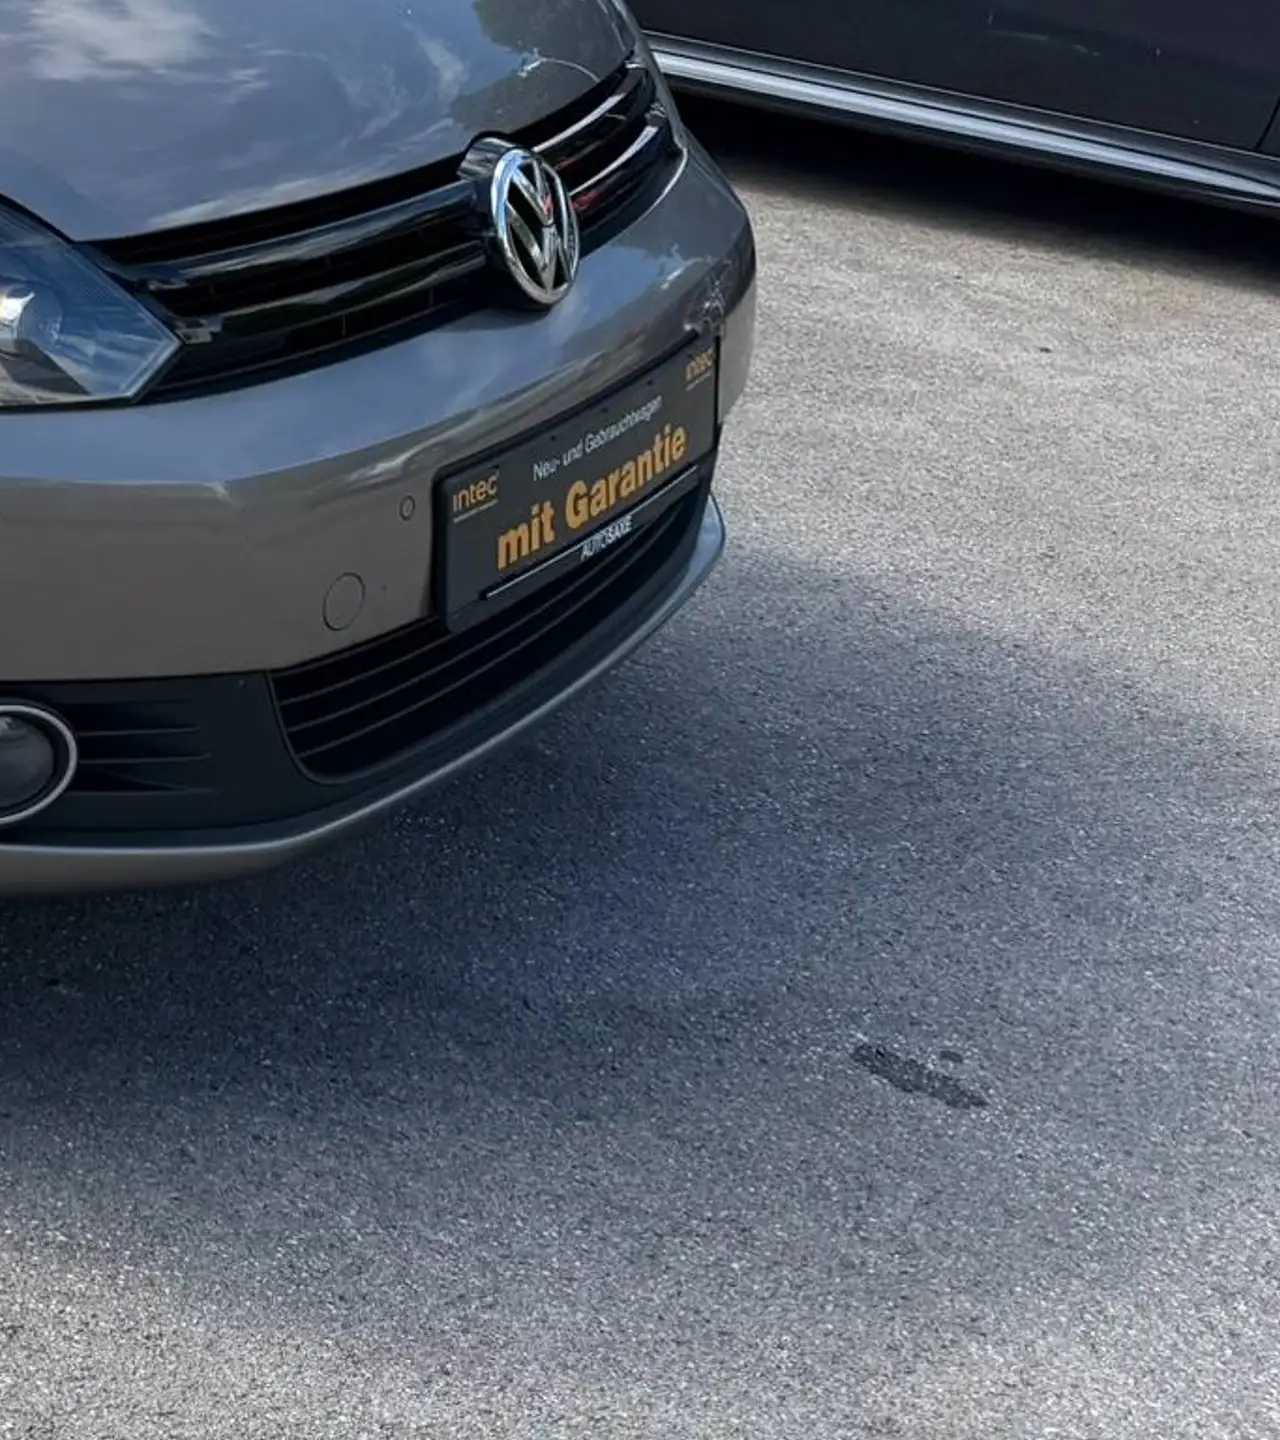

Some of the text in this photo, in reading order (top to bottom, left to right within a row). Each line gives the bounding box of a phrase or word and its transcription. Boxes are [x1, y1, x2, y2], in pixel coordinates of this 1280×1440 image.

[532, 458, 561, 482] Neu-
[563, 439, 584, 467] und
[452, 474, 499, 513] intec
[497, 423, 688, 571] mit Garantie
